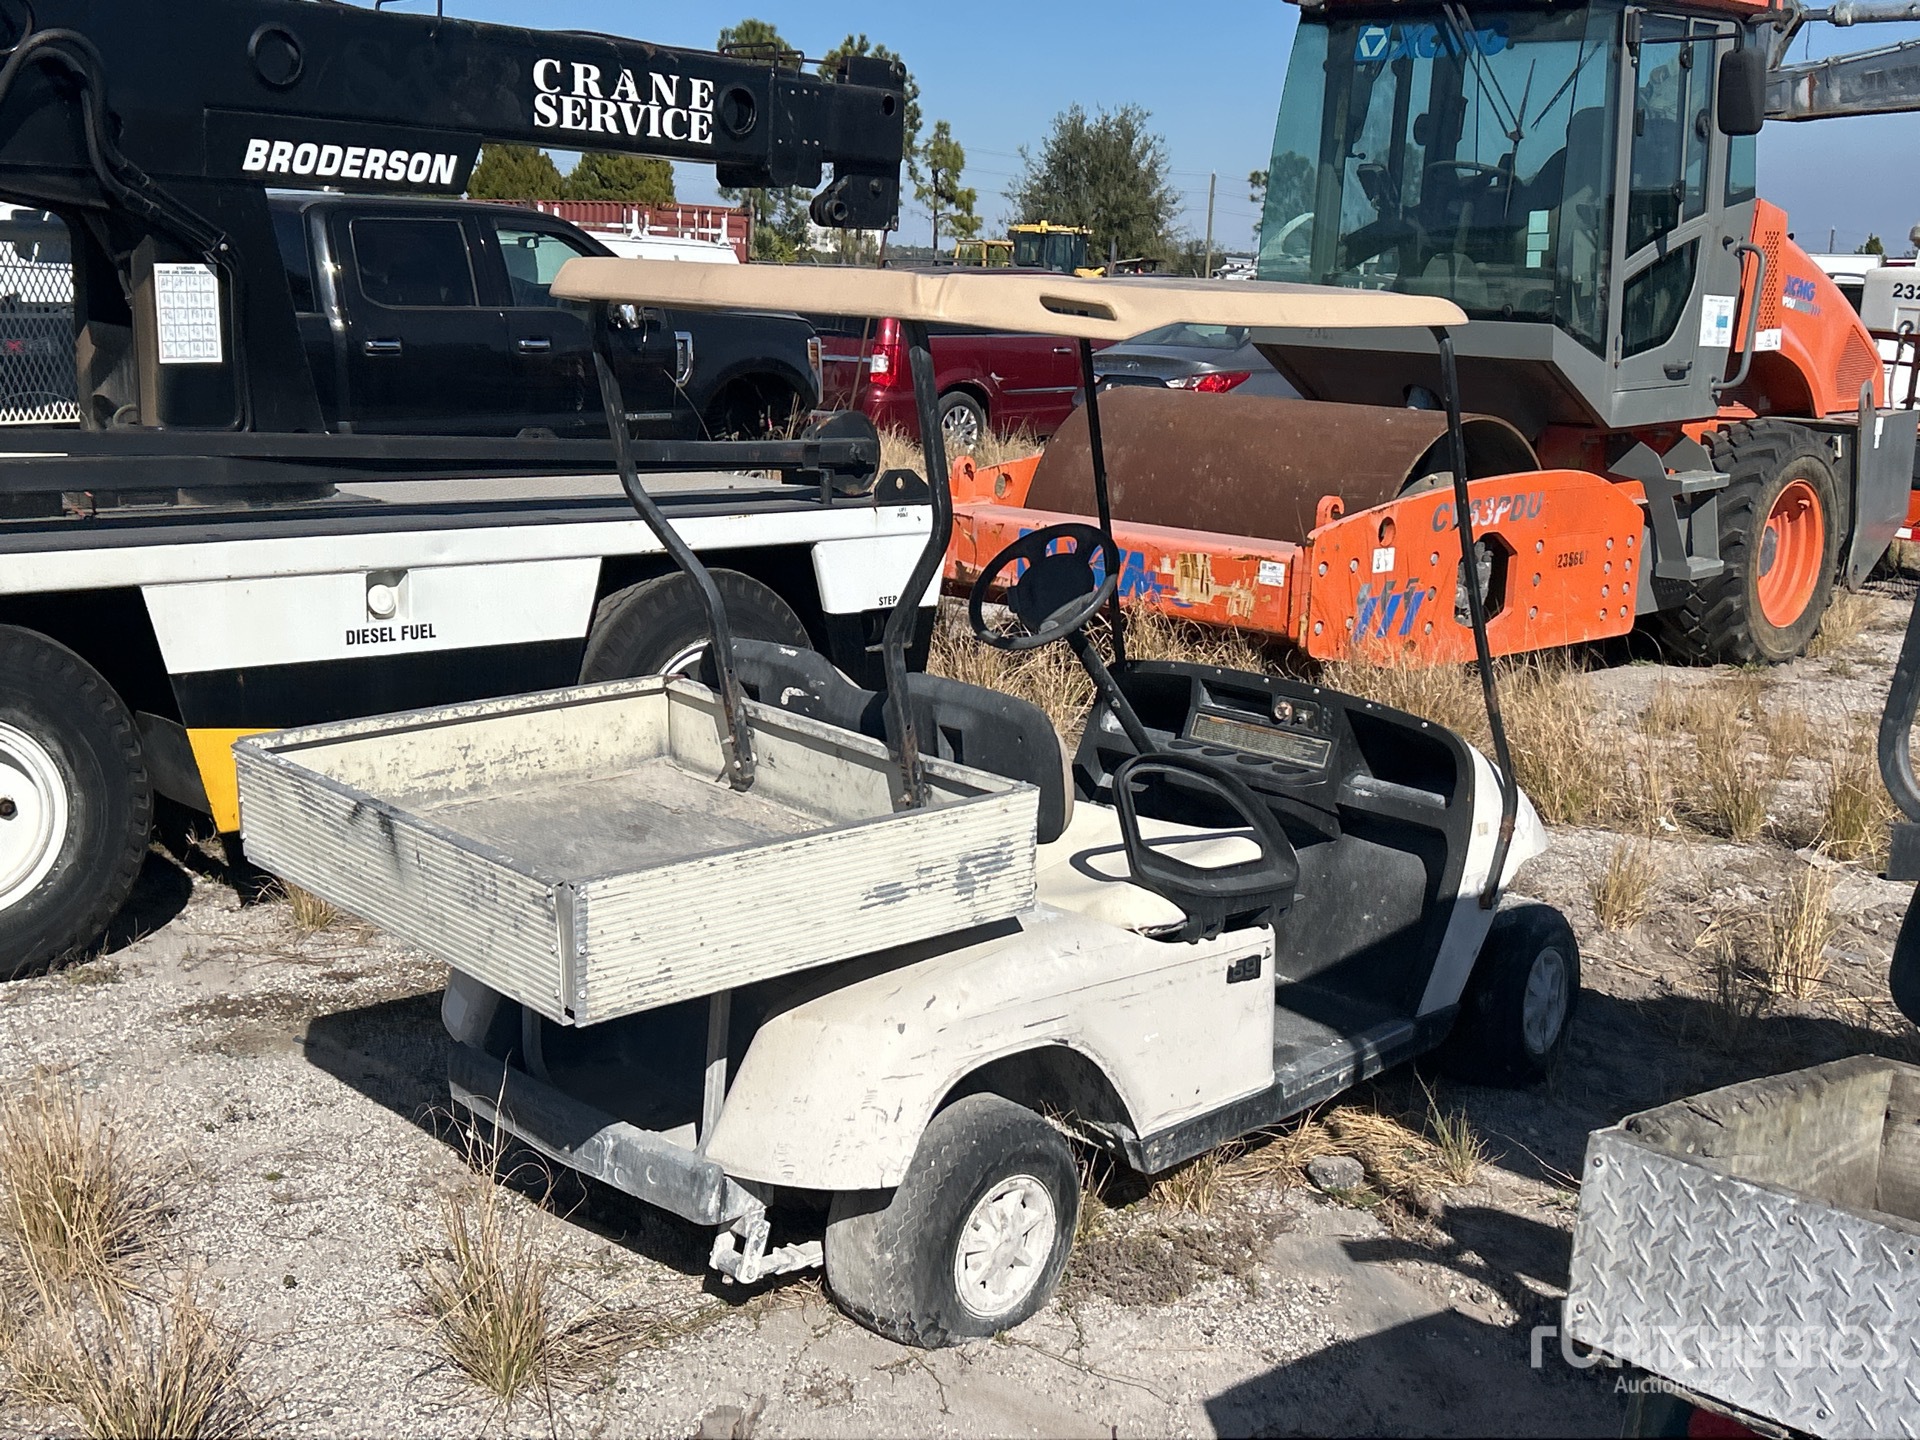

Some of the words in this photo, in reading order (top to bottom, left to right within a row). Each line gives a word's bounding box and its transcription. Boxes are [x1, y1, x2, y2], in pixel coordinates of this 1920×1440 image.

[533, 58, 714, 112] CRANE
[534, 92, 713, 144] SERVICE
[242, 138, 458, 185] BRODERSON
[879, 595, 898, 606] STEP
[346, 627, 396, 645] DIESEL
[401, 623, 436, 641] FUEL
